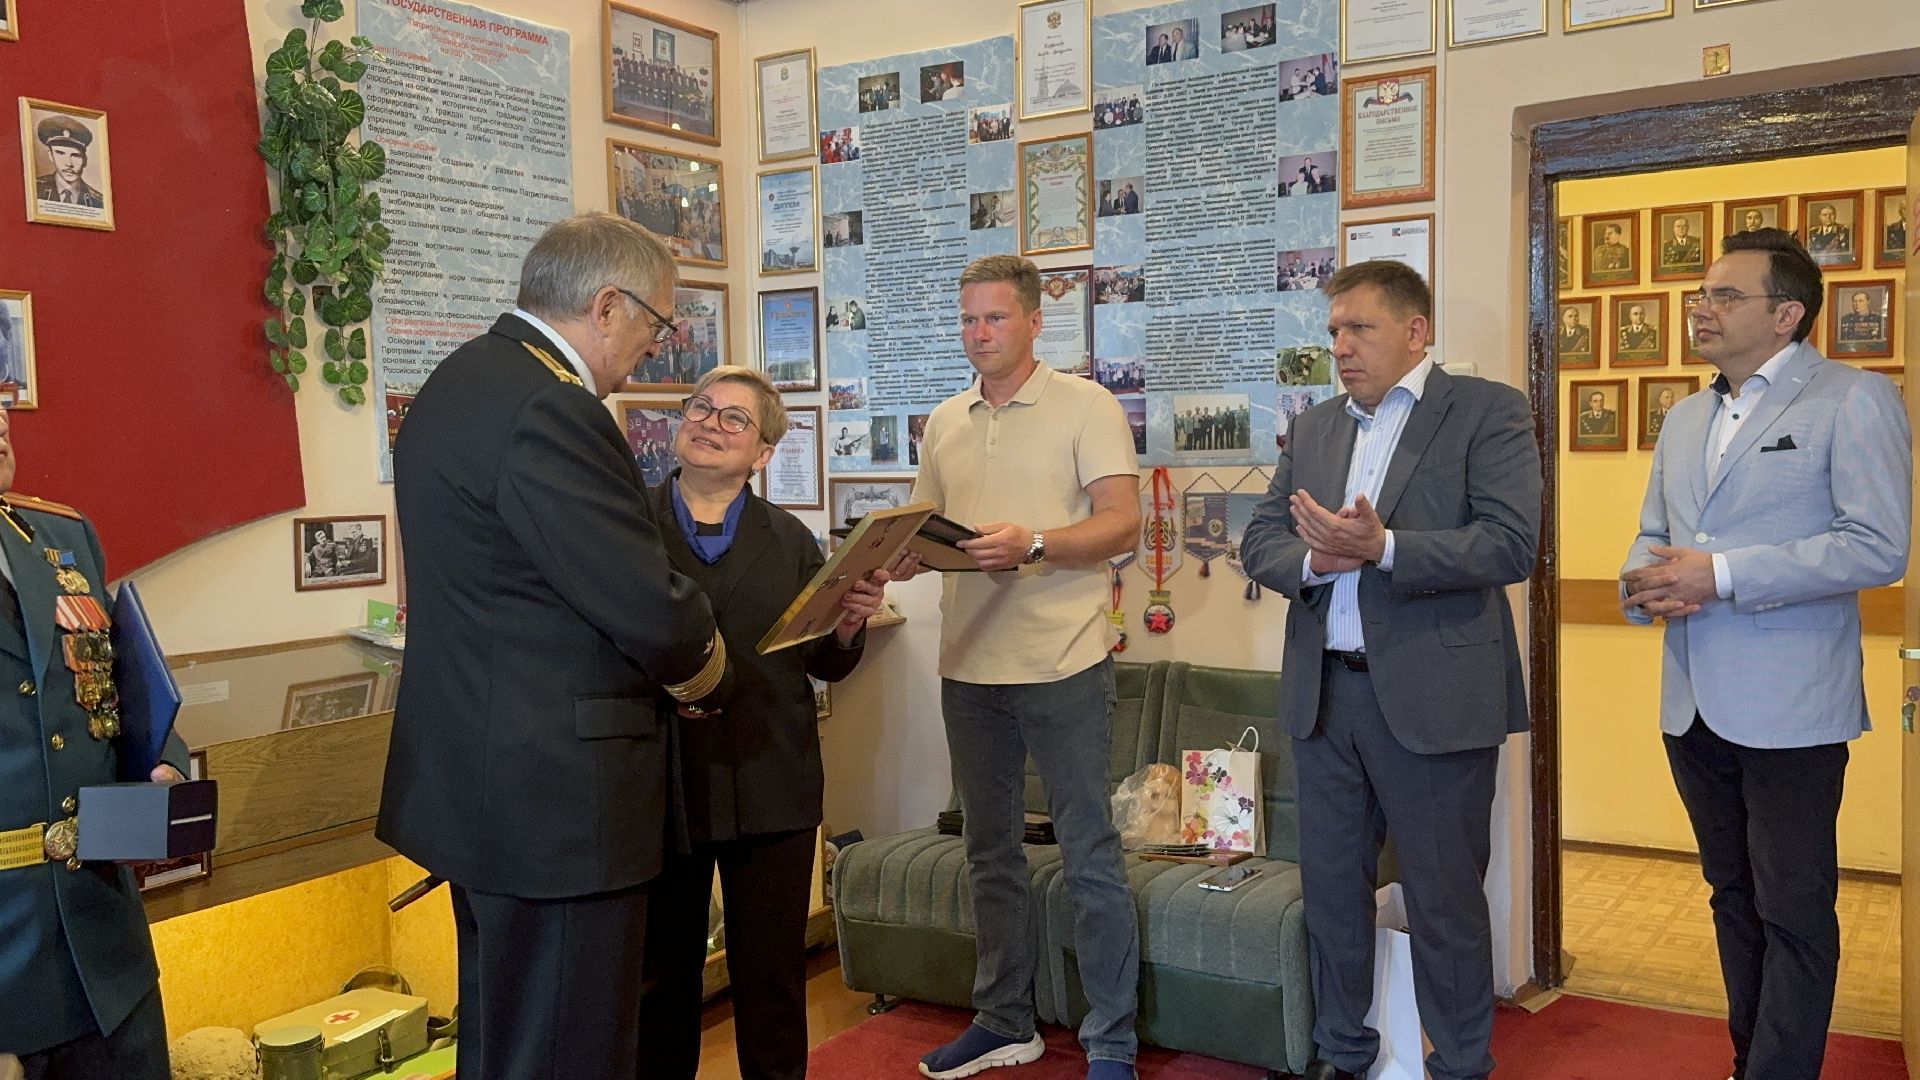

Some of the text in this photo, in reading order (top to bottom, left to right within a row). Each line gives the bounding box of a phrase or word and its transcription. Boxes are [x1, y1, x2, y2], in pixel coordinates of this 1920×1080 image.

[489, 22, 548, 45] ПРОГРАММА
[366, 73, 403, 87] способной
[415, 84, 439, 94] основе
[440, 90, 478, 102] воспитания
[479, 98, 500, 107] любви
[427, 76, 464, 90] воспитания
[466, 85, 493, 96] граждан
[494, 89, 530, 104] Российской
[460, 74, 500, 88] дальнейшее
[505, 85, 535, 96] развитие
[539, 92, 566, 103] системы
[366, 94, 420, 110] сформировать
[425, 105, 430, 114] у
[435, 107, 464, 119] граждан
[528, 127, 556, 138] сознания
[366, 104, 417, 120] обеспечивать
[422, 115, 467, 129] поддержание
[472, 124, 519, 139] общественной
[442, 100, 487, 114] исторических
[496, 110, 526, 122] традиций
[533, 118, 566, 131] Отечества
[367, 115, 406, 128] упрочение
[414, 123, 446, 134] единства
[465, 133, 491, 145] дружбы
[498, 139, 525, 150] народов
[531, 144, 566, 158] Российской
[389, 149, 433, 161] завершение
[442, 157, 475, 168] создания
[495, 166, 525, 177] развития
[380, 187, 398, 195] тания
[400, 190, 429, 201] граждан
[429, 192, 467, 205] Российской
[427, 175, 489, 191] функционирование
[491, 185, 518, 194] системы
[519, 188, 568, 203] Патриотического
[388, 198, 435, 210] мобилизация
[440, 205, 456, 213] всех
[476, 211, 509, 221] общества
[774, 202, 800, 211] ДИПЛОМ
[408, 220, 440, 231] сознания
[471, 228, 512, 240] обеспечение
[425, 242, 464, 253] воспитании
[471, 248, 493, 257] семьи,
[391, 267, 444, 280] формирование
[448, 274, 466, 283] норм
[470, 277, 505, 285] поведения
[398, 260, 438, 271] институтов,
[384, 287, 396, 295] его
[401, 288, 439, 298] готовности
[452, 294, 491, 303] реализации
[381, 346, 422, 355] Программы
[387, 336, 426, 346] Основным
[383, 366, 422, 376] Российской
